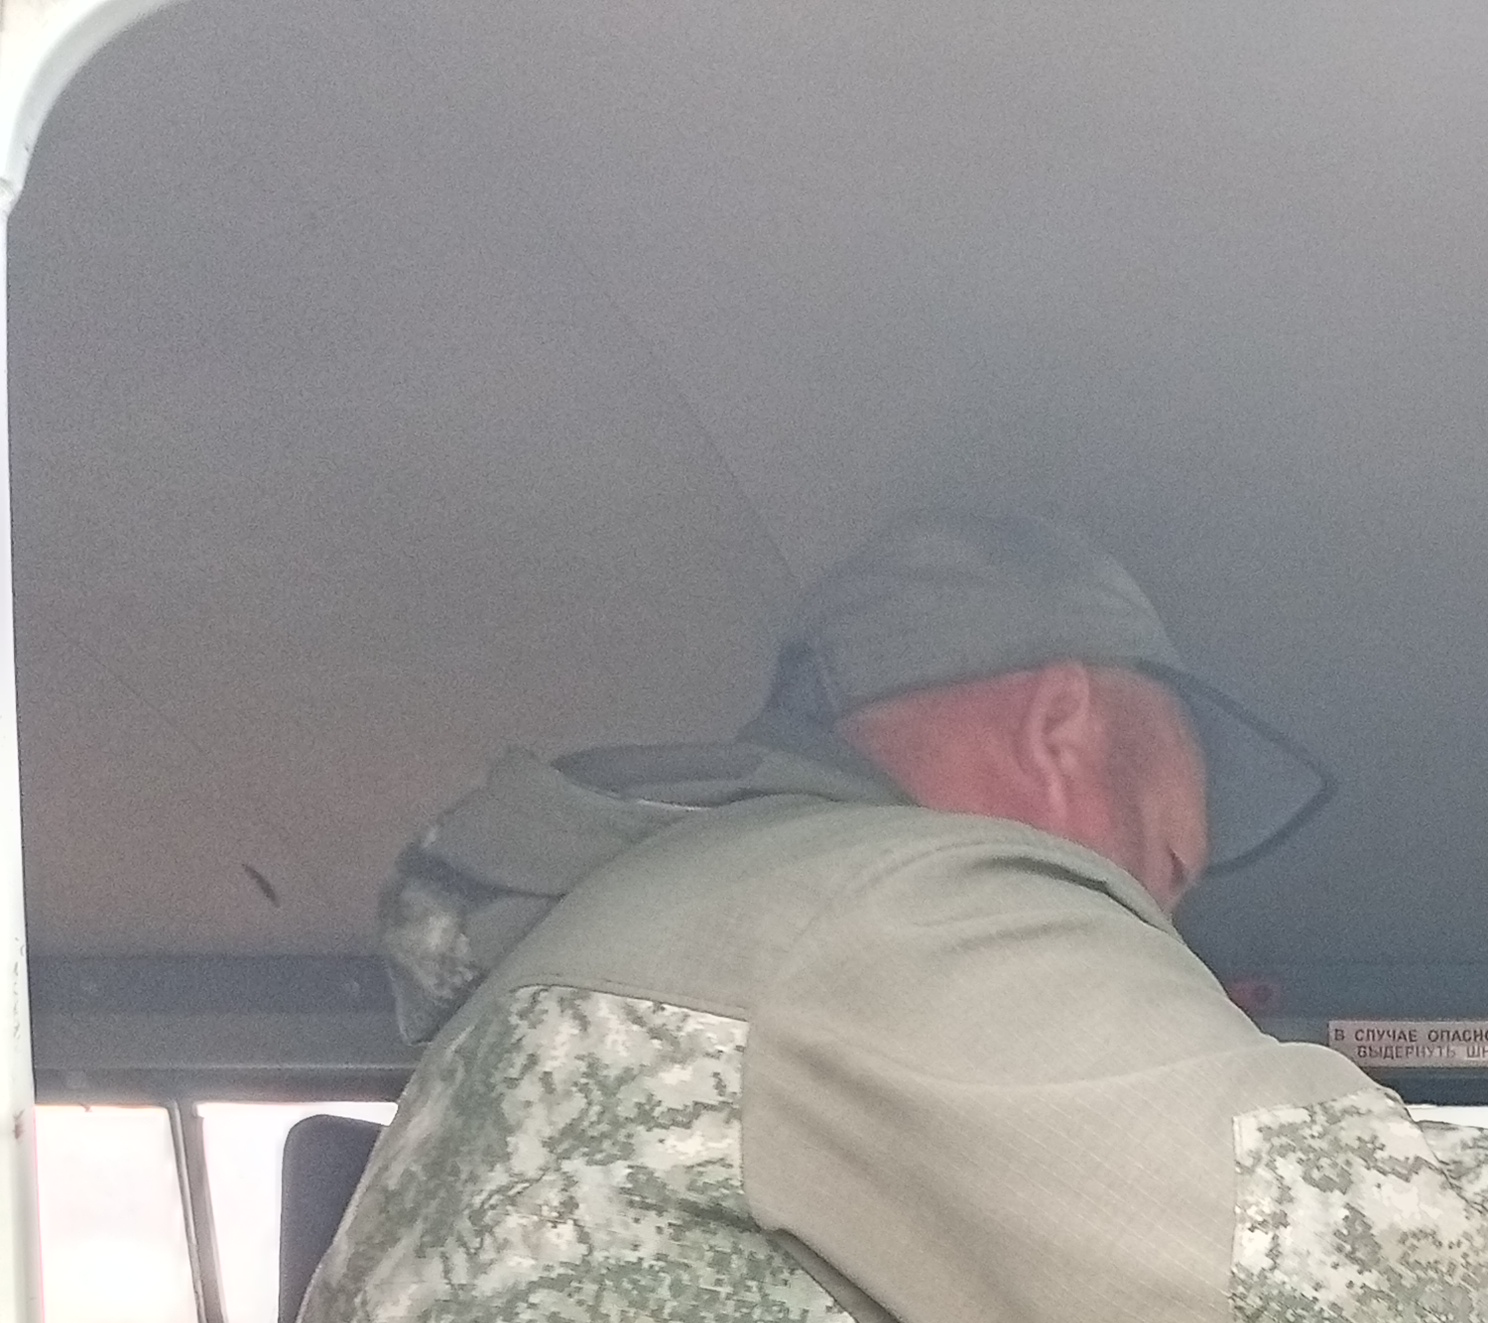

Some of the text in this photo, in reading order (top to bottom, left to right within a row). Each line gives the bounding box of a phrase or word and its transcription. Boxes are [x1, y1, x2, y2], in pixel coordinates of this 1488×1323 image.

[1334, 1028, 1345, 1041] В
[1354, 1028, 1418, 1043] СЛУЧАЕ
[1356, 1045, 1456, 1060] ВЫДЕРНУТЬ
